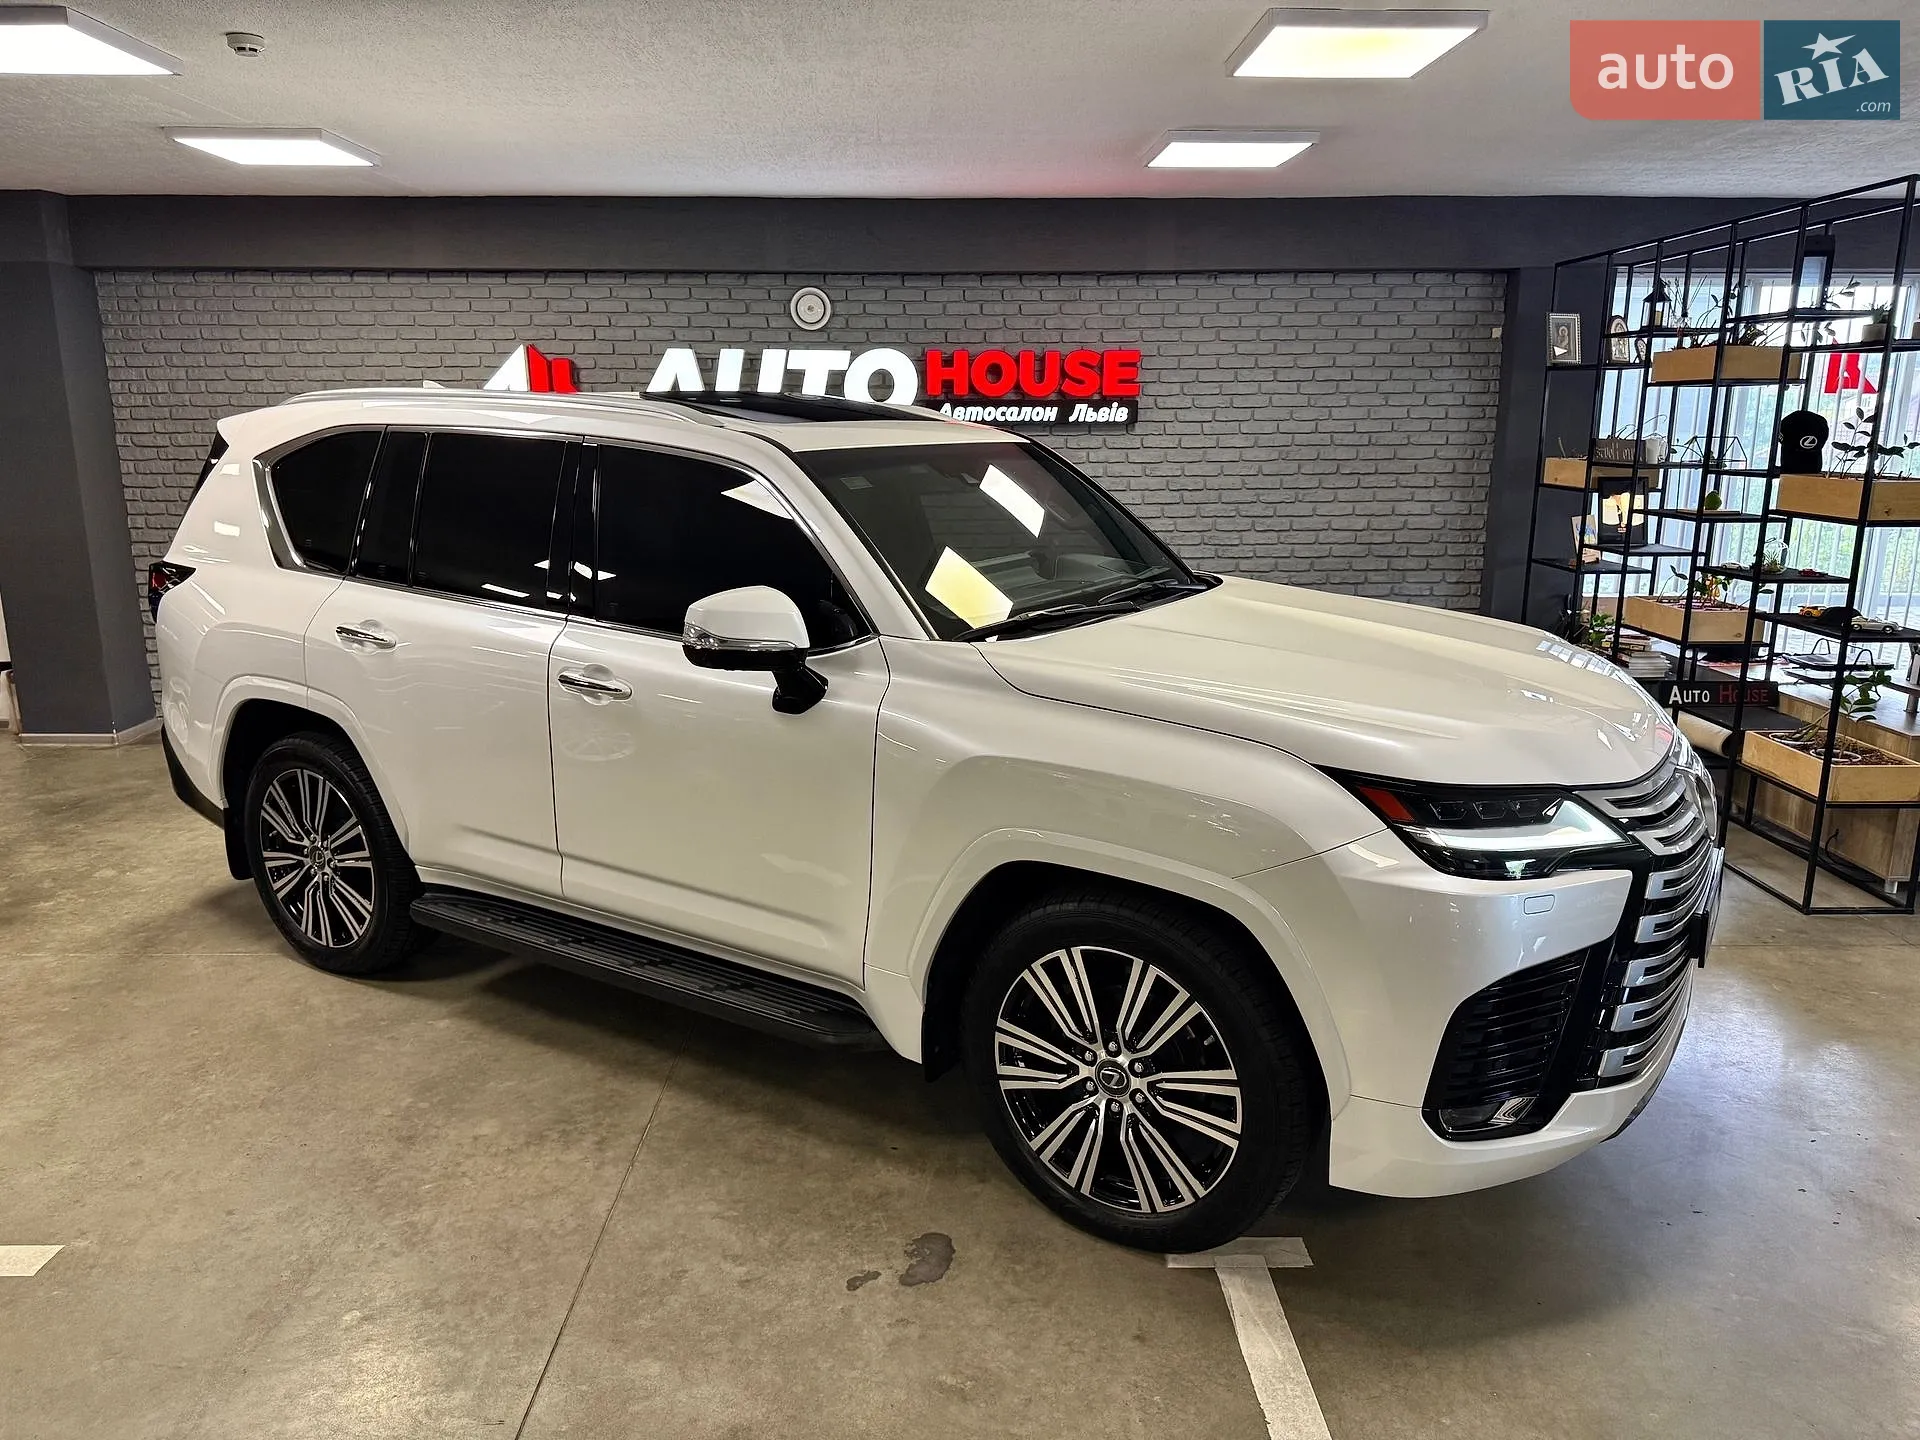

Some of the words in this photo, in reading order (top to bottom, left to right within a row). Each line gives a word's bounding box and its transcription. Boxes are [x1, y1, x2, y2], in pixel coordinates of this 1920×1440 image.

[645, 347, 919, 407] AUTO
[925, 349, 1141, 398] HOUSE
[940, 402, 1059, 422] Автосалон
[1068, 401, 1129, 422] Львів
[1668, 685, 1710, 705] AUTO
